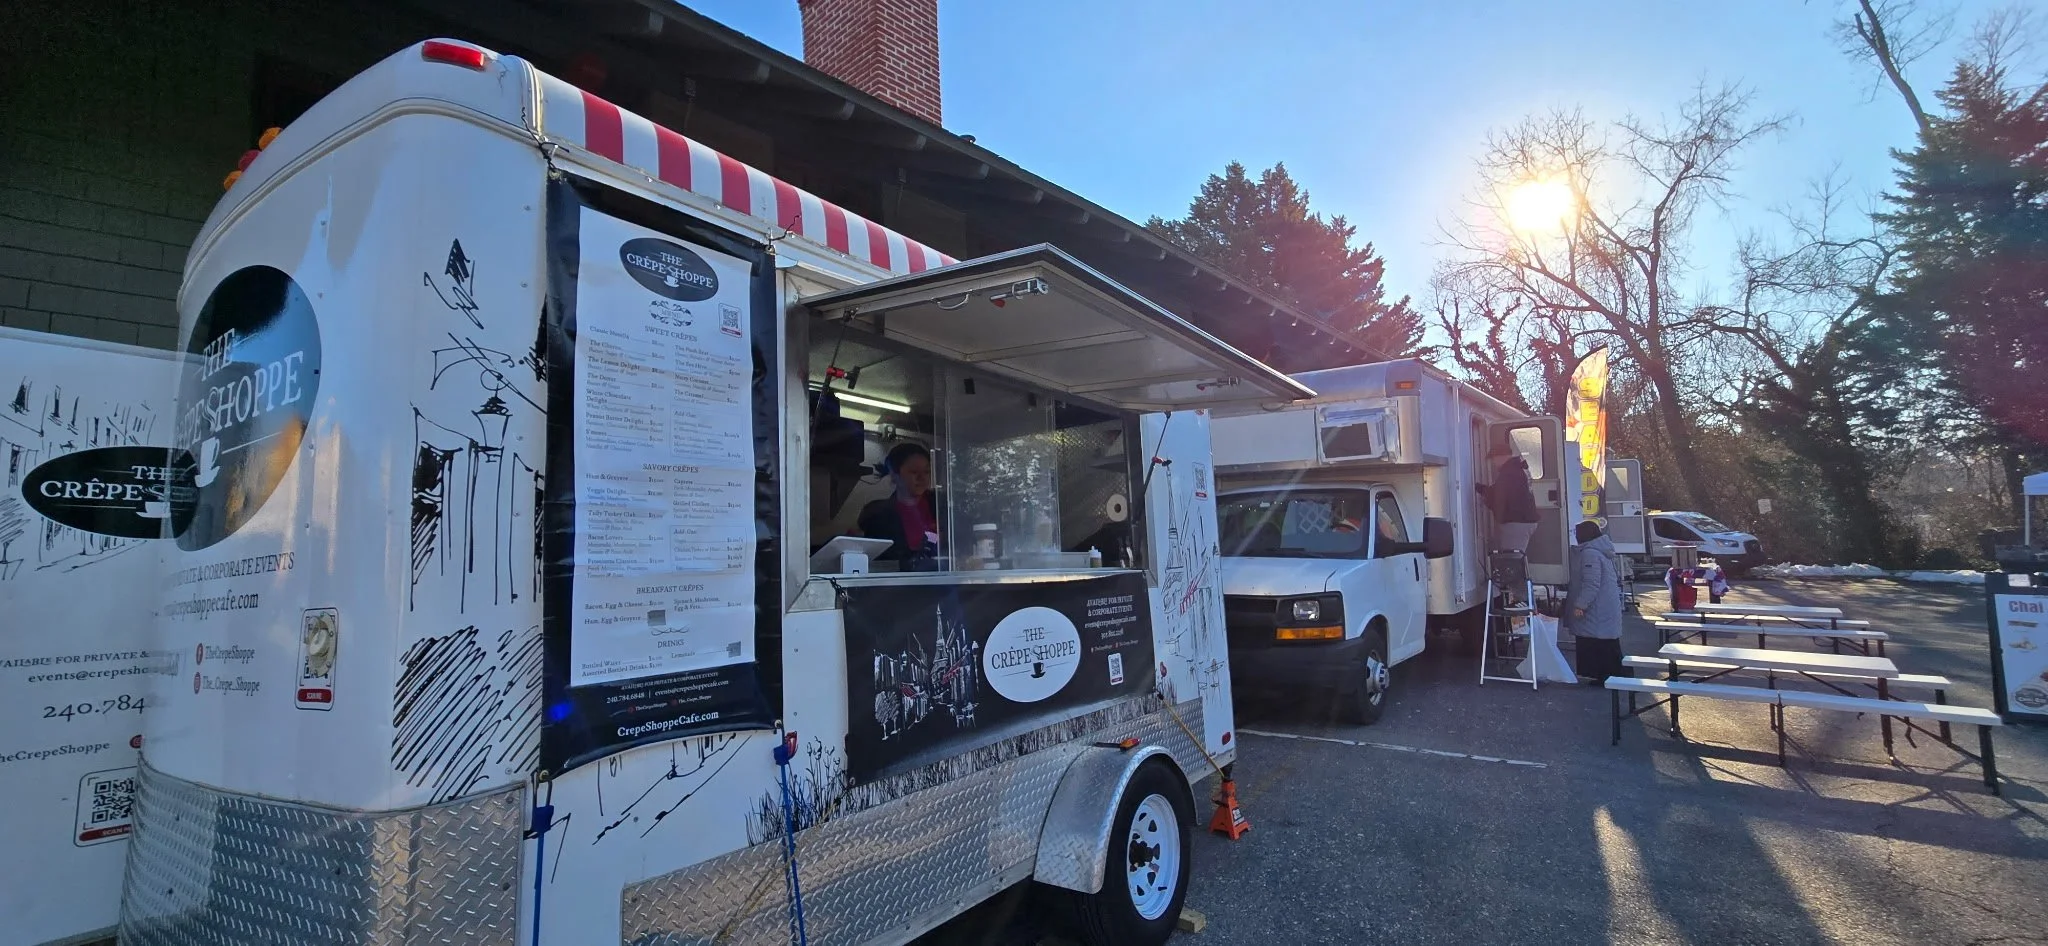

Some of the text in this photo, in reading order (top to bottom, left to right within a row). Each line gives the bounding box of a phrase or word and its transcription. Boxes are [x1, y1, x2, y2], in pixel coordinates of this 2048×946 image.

[660, 251, 682, 267] THE
[626, 252, 714, 288] CRÊPE SHOPPE
[610, 329, 629, 339] Nutella
[644, 325, 698, 342] SWEET CRÊPES
[202, 327, 236, 382] THE
[675, 344, 685, 352] The
[588, 355, 599, 363] The
[600, 357, 619, 367] Lemon
[620, 361, 640, 371] Delight
[587, 371, 598, 379] The
[203, 350, 304, 434] SHOPPE
[586, 388, 632, 400] White Chocolate
[675, 388, 684, 396] The
[586, 395, 608, 405] Delight
[586, 411, 605, 420] Peanut
[606, 414, 623, 422] Butter
[624, 416, 644, 425] Delight
[642, 463, 699, 474] SAVORY CRÊPES
[40, 477, 143, 501] CRÊPE
[586, 486, 606, 494] Veggie
[606, 488, 627, 496] Delight
[672, 499, 691, 507] Grilled
[603, 510, 622, 518] Turkey
[203, 557, 255, 582] CORPORATE
[254, 551, 295, 575] EVENTS
[636, 583, 705, 595] BREAKFAST CRÊPES
[605, 602, 617, 610] Egg
[1108, 596, 1117, 605] FOR
[2008, 600, 2044, 614] Chai
[673, 604, 684, 612] Egg
[1087, 604, 1133, 617] & CORPORATE EVENTS
[600, 617, 613, 625] Egg
[1022, 626, 1045, 642] THE
[657, 638, 685, 649] DRINKS
[55, 655, 81, 665] FOR
[84, 651, 138, 663] PRIVATE
[139, 650, 149, 659] &
[204, 644, 256, 665] TheCrepeShoppe
[671, 651, 696, 659] Lemonade
[991, 639, 1076, 670] CRÊPE SHOPPE
[581, 660, 603, 670] Bottled
[581, 667, 607, 678] Assorted
[607, 665, 628, 675] Bottled
[653, 678, 674, 687] PRIVATE
[677, 673, 701, 683] CORPORATE
[701, 671, 719, 680] EVENTS
[606, 679, 729, 704] 240.784.6848 events@crepeshoppecafe.com
[617, 710, 720, 737] CrepeShoppeCafe.com
